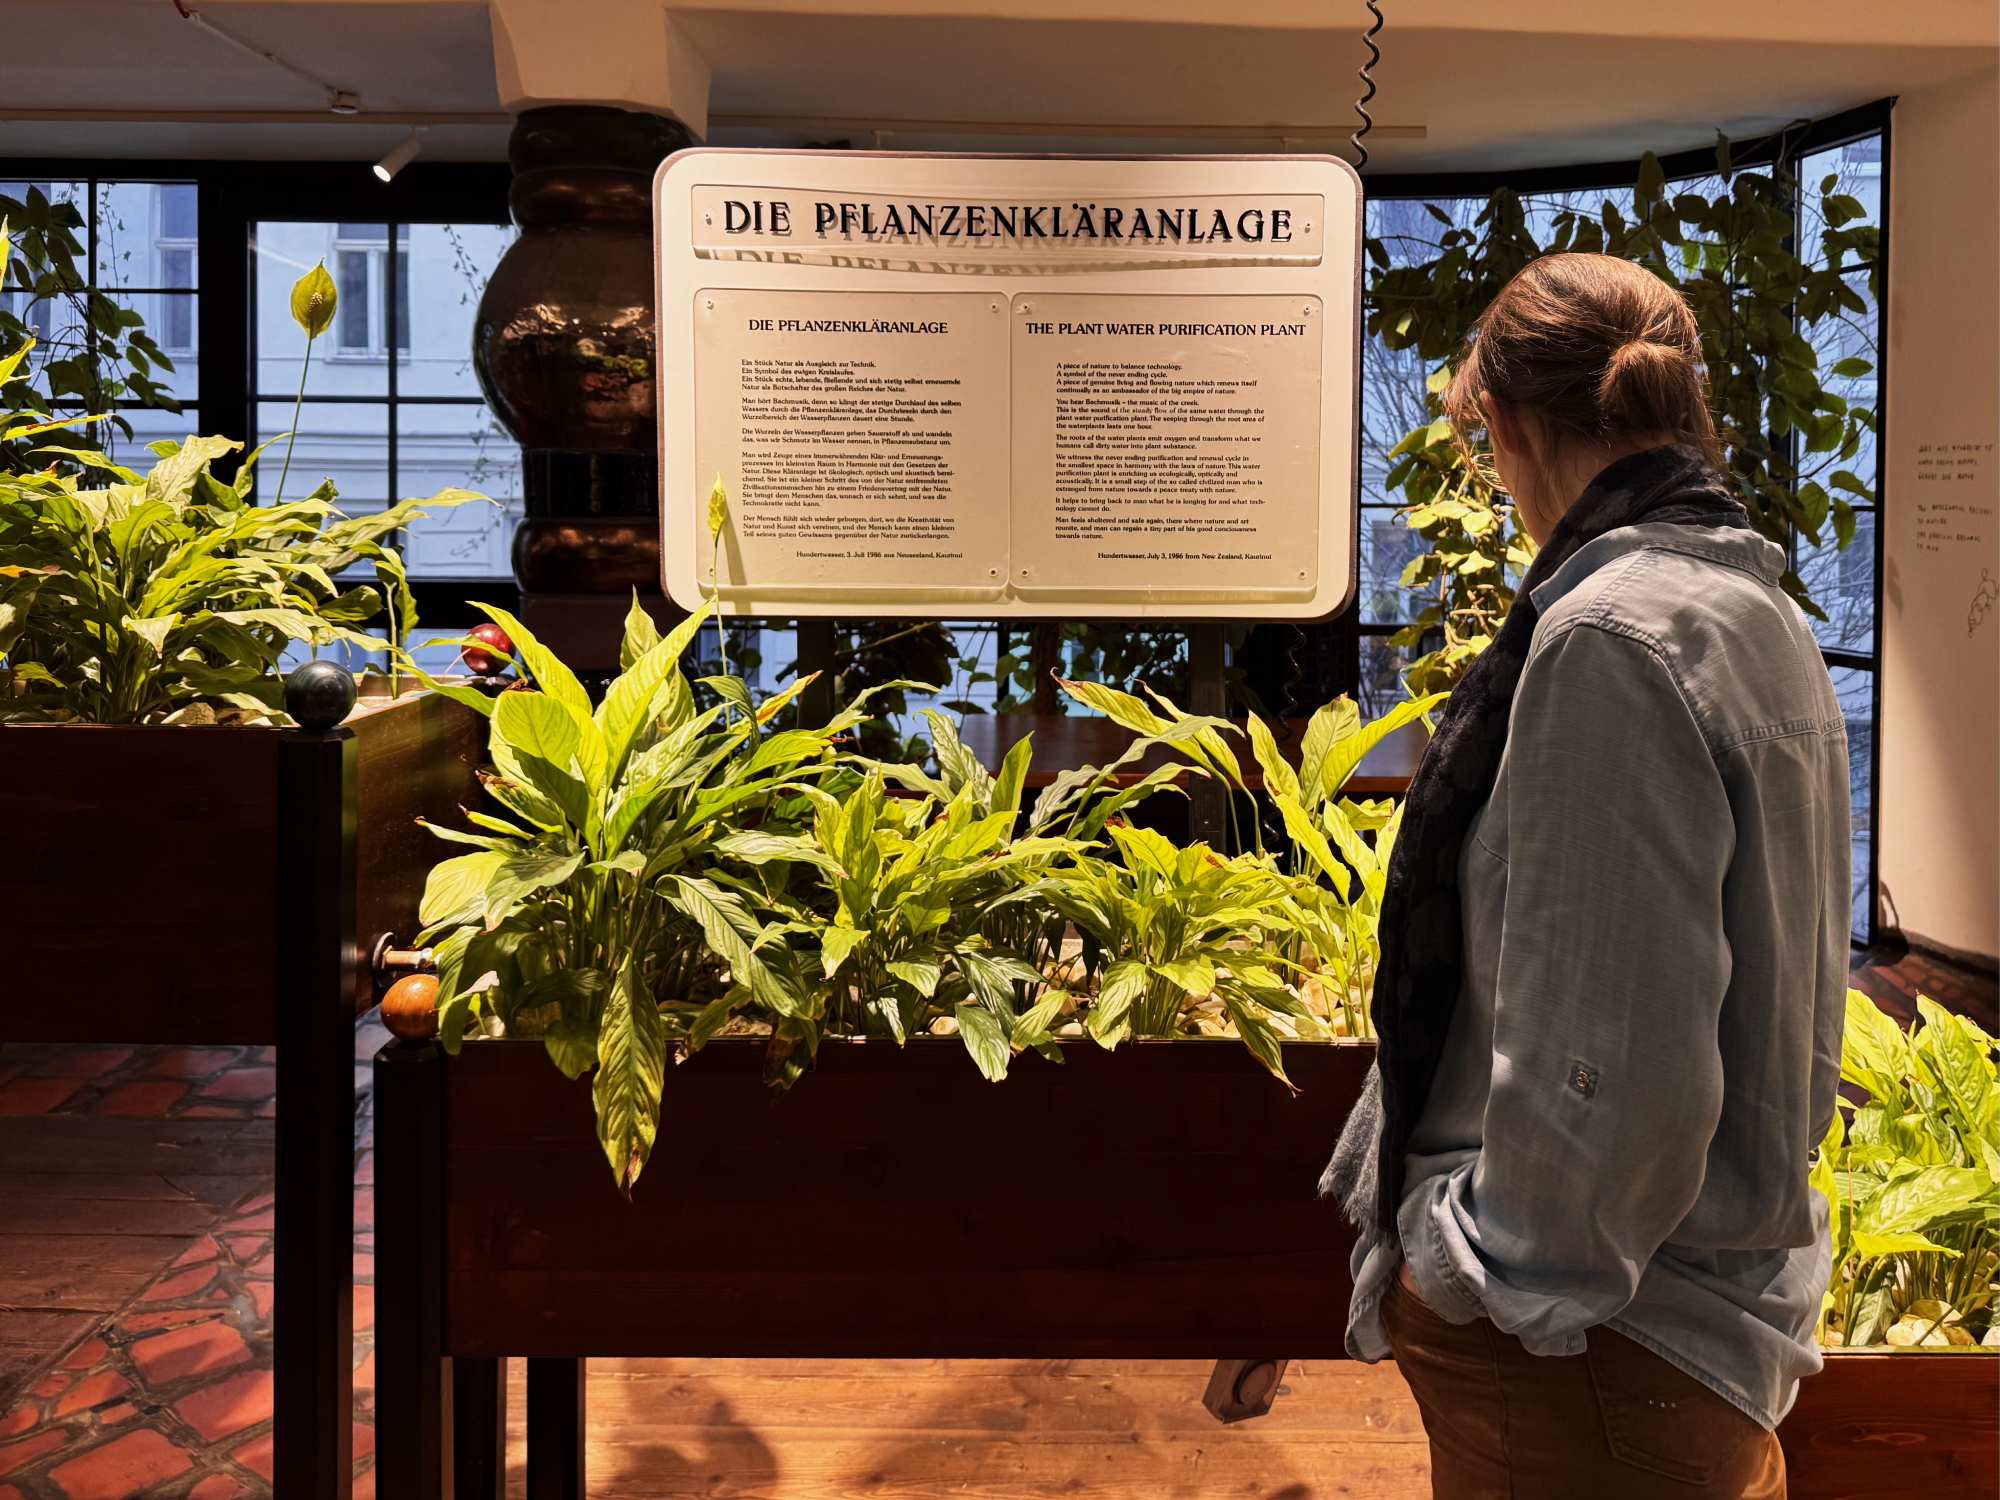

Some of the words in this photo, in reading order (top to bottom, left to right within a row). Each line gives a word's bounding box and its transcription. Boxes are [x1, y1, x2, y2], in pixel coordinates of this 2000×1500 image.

[725, 201, 791, 234] DIE
[815, 202, 1292, 241] PFLANZENKLÄRANLAGE
[749, 319, 774, 331] DIE
[778, 319, 949, 334] PFLANZENKLÄRANLAGE
[1025, 322, 1055, 335] THE
[1058, 322, 1105, 335] PLANT
[1105, 323, 1155, 336] WATER
[1158, 323, 1257, 336] PURIFICATION
[1260, 324, 1306, 336] PLANT
[741, 358, 752, 366] Ein
[754, 358, 772, 366] Stück
[805, 359, 836, 368] Ausgleich
[850, 360, 876, 368] Technik.
[1063, 361, 1080, 370] piece
[1082, 361, 1088, 369] of
[1120, 362, 1145, 370] balance
[741, 366, 752, 374] Ein
[754, 366, 778, 375] Symbol
[793, 367, 816, 376] ewigen
[1127, 370, 1148, 379] ending
[1150, 370, 1167, 379] cycle.
[855, 376, 867, 384] und
[884, 376, 902, 385] stetig
[1063, 378, 1080, 386] piece
[1089, 378, 1114, 387] genuine
[1116, 378, 1134, 387] living
[1135, 378, 1147, 386] and
[1149, 378, 1172, 387] flowing
[1174, 378, 1194, 386] nature
[824, 384, 846, 393] großen
[848, 384, 873, 392] Reiches
[1151, 386, 1157, 394] of
[1159, 386, 1169, 394] the
[1171, 387, 1181, 395] big
[1183, 387, 1204, 396] empire
[1056, 397, 1068, 405] You
[1069, 397, 1084, 405] hear
[1160, 398, 1166, 406] of
[1168, 398, 1178, 406] the
[800, 413, 850, 422] Wasserpflanzen
[852, 414, 872, 422] dauert
[874, 414, 888, 422] eine
[1056, 433, 1067, 441] The
[1069, 433, 1085, 441] roots
[1087, 433, 1094, 441] of
[1095, 433, 1106, 441] the
[1126, 434, 1146, 442] plants
[1188, 434, 1200, 442] and
[1234, 434, 1250, 442] what
[1055, 441, 1081, 449] humans
[1083, 441, 1094, 449] call
[1095, 441, 1110, 450] dirty
[1145, 442, 1161, 450] plant
[1055, 504, 1076, 513] nology
[776, 522, 796, 530] Kunst
[894, 523, 910, 531] kann
[912, 523, 929, 531] einen
[778, 530, 796, 539] guten
[880, 531, 898, 539] Natur
[1055, 531, 1081, 539] towards
[1147, 552, 1160, 560] July
